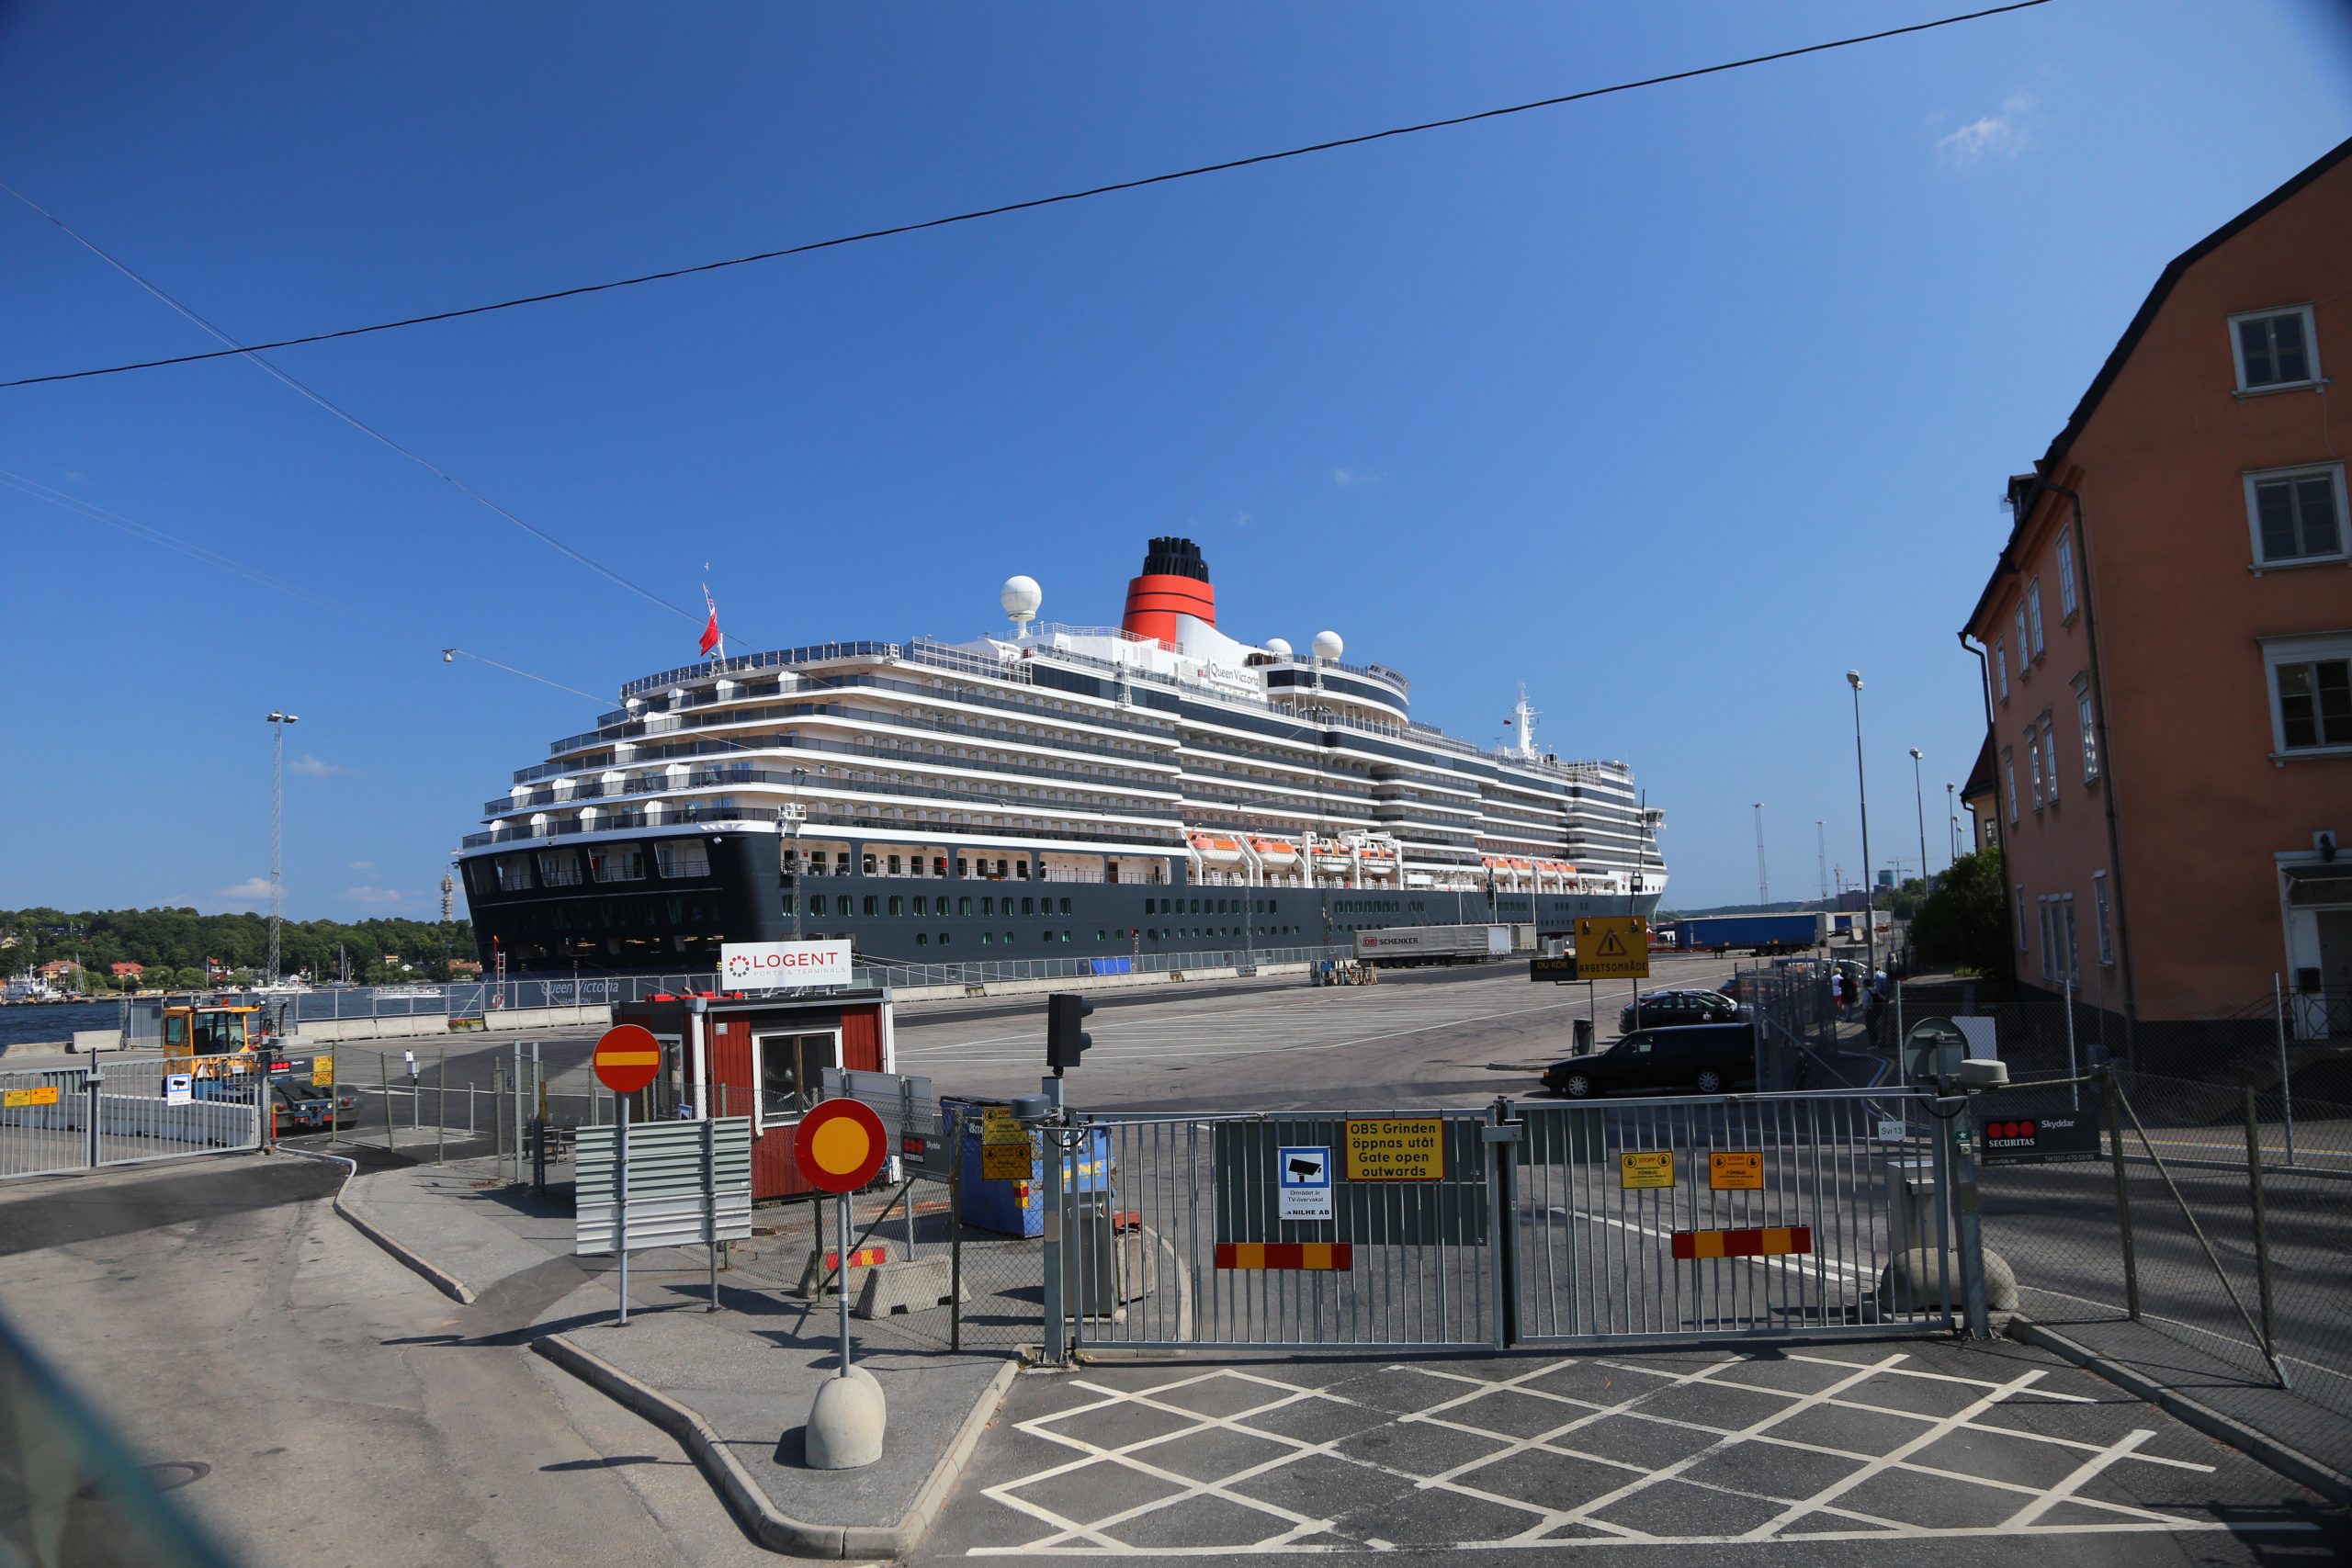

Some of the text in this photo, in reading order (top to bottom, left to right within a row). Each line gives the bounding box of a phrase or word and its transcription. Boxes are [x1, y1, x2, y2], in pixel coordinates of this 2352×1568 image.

[1211, 662, 1259, 686] Queen Victoria
[1363, 938, 1376, 946] DB
[753, 953, 838, 968] LOGENT
[1579, 960, 1646, 973] ARBETSOMRÅDE
[1351, 1123, 1436, 1134] OBS Grinden
[2041, 1120, 2075, 1129] Skyddar
[1881, 1127, 1893, 1135] Svi
[1352, 1137, 1434, 1151] öppnas utåt
[1989, 1139, 2035, 1147] SECURITAS
[1359, 1152, 1429, 1164] Gate open
[1362, 1166, 1427, 1177] outwards
